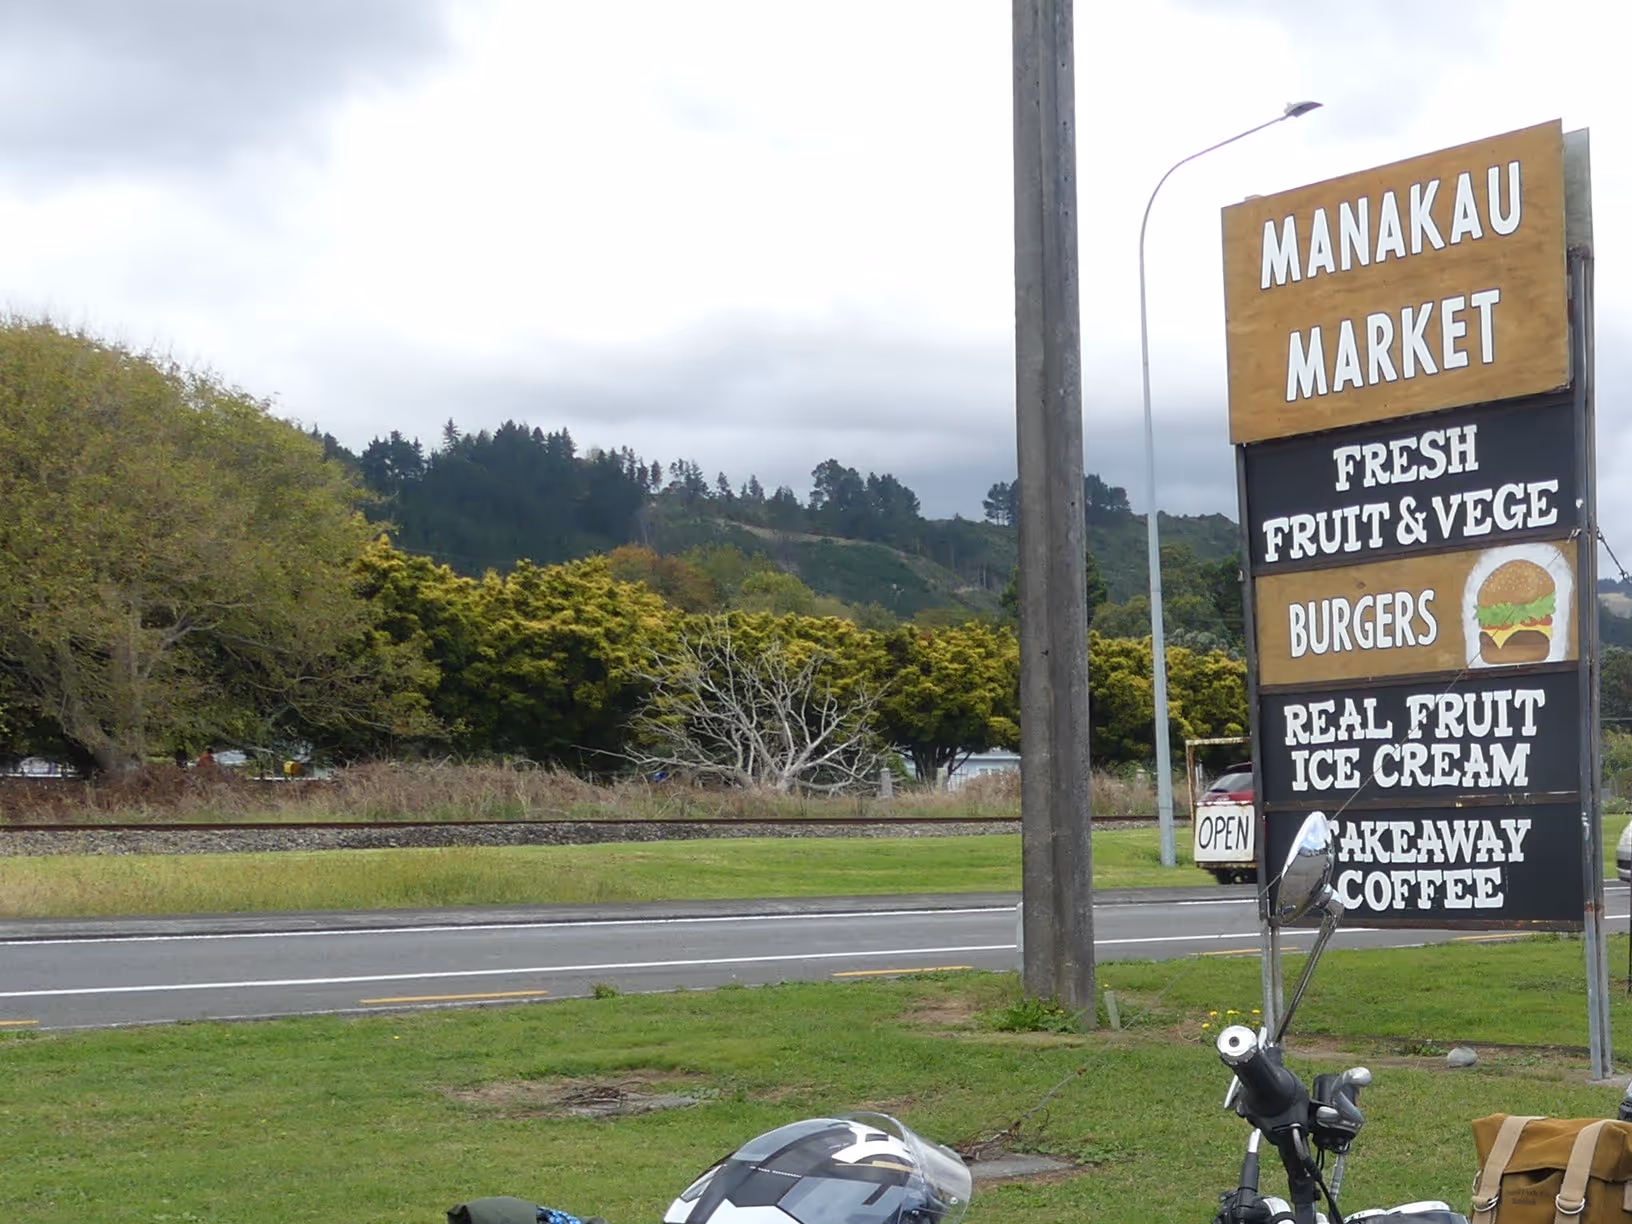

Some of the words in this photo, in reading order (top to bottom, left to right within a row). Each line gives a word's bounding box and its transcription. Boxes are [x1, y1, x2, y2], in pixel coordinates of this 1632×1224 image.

[1260, 160, 1522, 290] MANAKAU
[1286, 288, 1500, 402] MARKET
[1333, 424, 1479, 492] FRESH
[1263, 502, 1390, 562] FRUIT
[1396, 496, 1427, 545] &
[1432, 479, 1559, 539] VEGE
[1288, 589, 1438, 658] BURGERS
[1284, 698, 1393, 746] REAL
[1406, 689, 1546, 739] FRUIT
[1291, 748, 1360, 791] ICE
[1372, 743, 1531, 788] CREAM
[1199, 815, 1249, 850] OPEN
[1337, 867, 1504, 911] COFFEE
